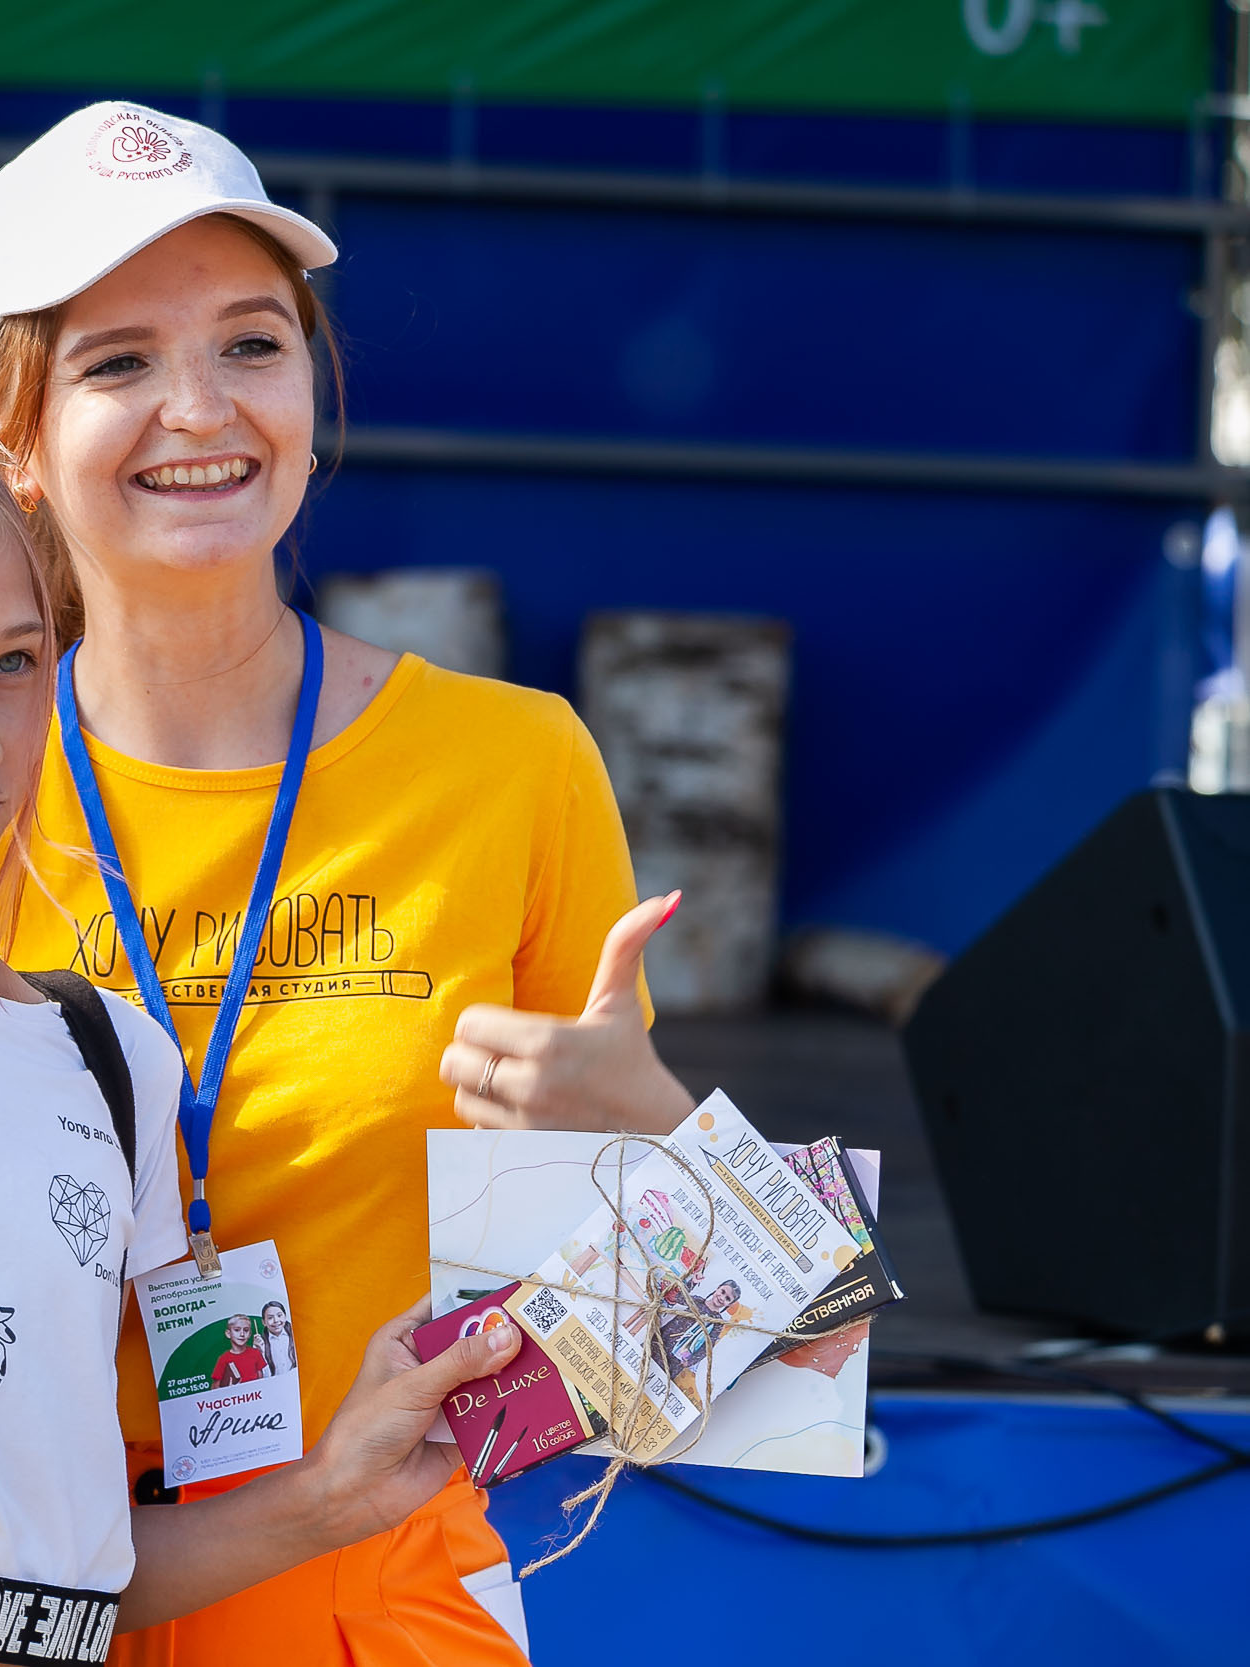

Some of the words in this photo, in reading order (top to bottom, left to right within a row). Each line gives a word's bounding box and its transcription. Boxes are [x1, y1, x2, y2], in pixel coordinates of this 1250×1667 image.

[116, 167, 174, 181] РУССКОГО
[69, 907, 176, 977] ХОУ
[191, 893, 395, 968] РИОВАТЬ
[279, 979, 351, 995] СТУДИЯ
[57, 1115, 91, 1140] Yong
[723, 1132, 774, 1182] ХОЧУ
[756, 1169, 827, 1250] РИСОВАТЬ
[722, 1172, 770, 1226] ХУДОЖЕСТВЕННАЯ
[769, 1224, 792, 1251] СТУДИЯ
[148, 1277, 190, 1292] Выставка
[151, 1282, 222, 1304] допобразования
[154, 1299, 207, 1318] ВОЛОГДА
[157, 1316, 194, 1333] ДЕТЯМ
[166, 1379, 176, 1388] 27
[176, 1374, 207, 1387] августа
[168, 1381, 210, 1397] 11:00-15:00
[196, 1390, 263, 1413] Участник
[449, 1393, 489, 1417] De
[493, 1366, 551, 1399] Luxe
[188, 1410, 287, 1448] Арина
[545, 1419, 572, 1436] цветов
[549, 1429, 577, 1446] colours
[532, 1432, 549, 1453] 16
